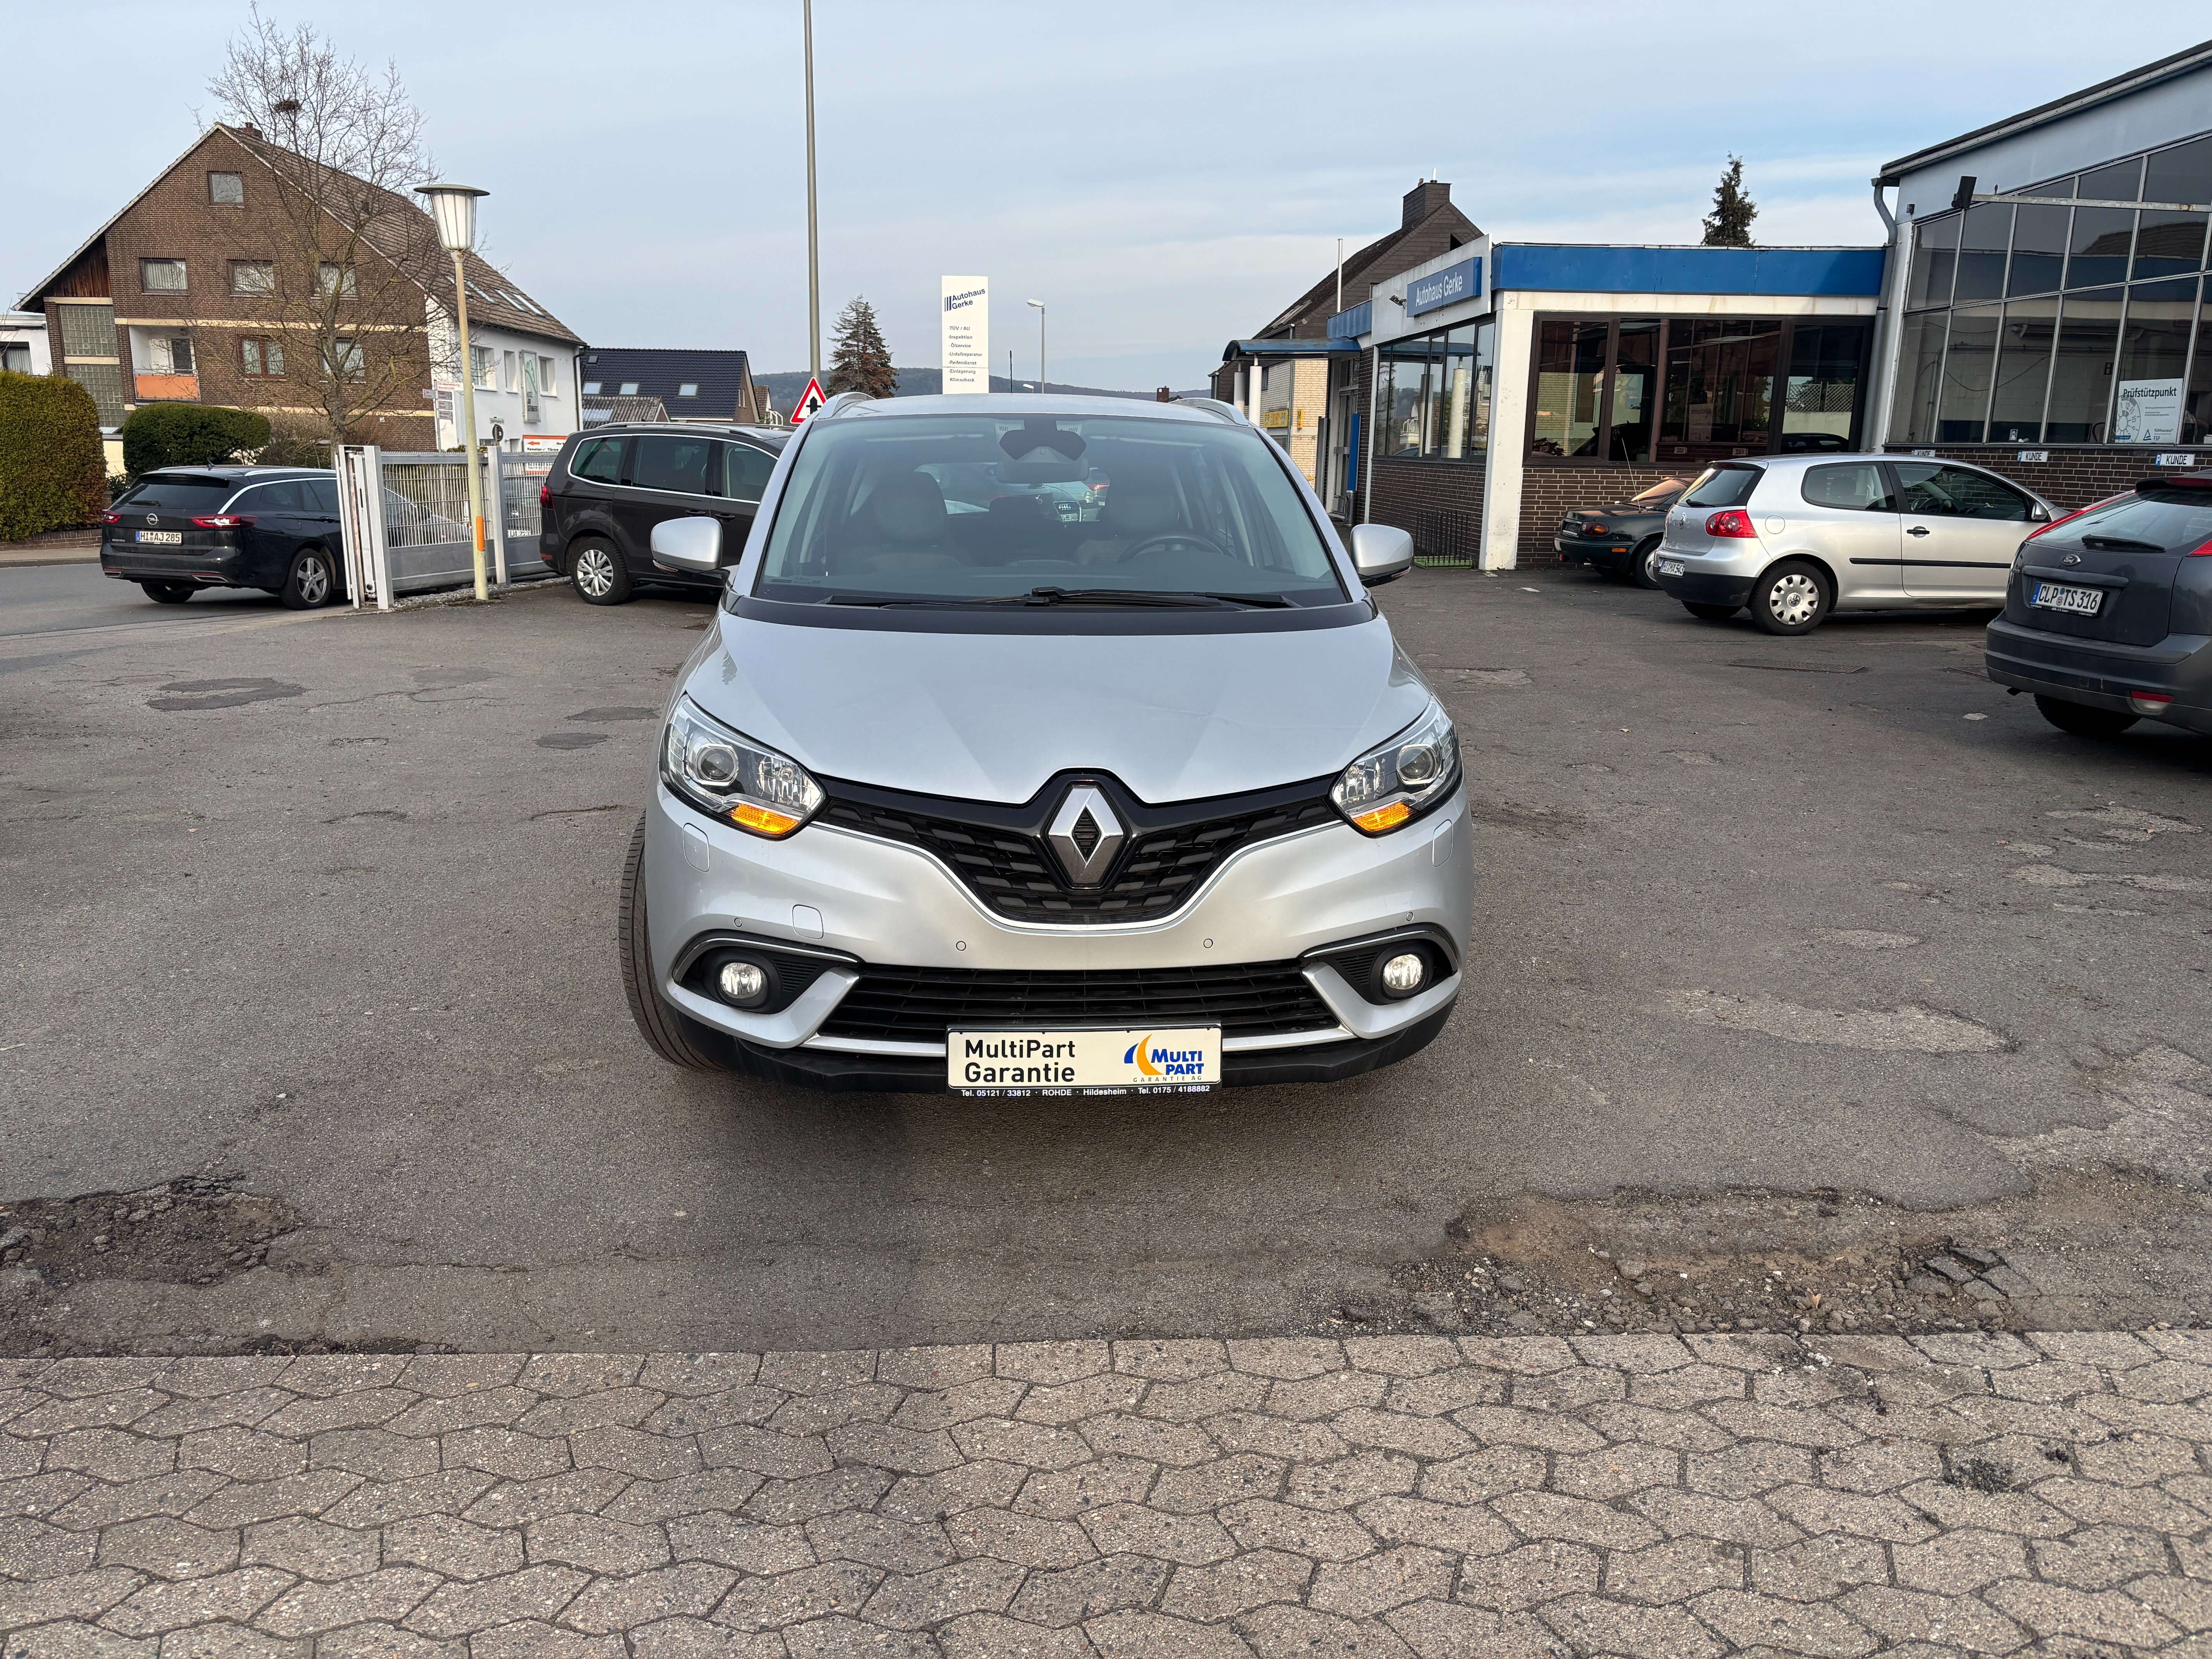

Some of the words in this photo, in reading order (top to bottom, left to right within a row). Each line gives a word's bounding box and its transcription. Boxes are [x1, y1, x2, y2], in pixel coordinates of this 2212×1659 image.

[952, 289, 986, 301] Autohaus
[1416, 283, 1442, 307] Autohaus
[1444, 272, 1463, 297] Gerke
[952, 300, 973, 309] Gerke
[2123, 386, 2177, 399] Prüfstützpunkt
[2026, 452, 2042, 460] KUNDE
[2156, 455, 2161, 465] P
[2166, 455, 2188, 465] KUNDE
[141, 532, 149, 541] HI
[154, 533, 164, 541] AJ
[166, 534, 180, 542] 285
[2039, 586, 2058, 603] CLP
[2063, 589, 2077, 606] TS
[2077, 592, 2099, 610] 316
[965, 1040, 1075, 1058] MultiPart
[1151, 1049, 1202, 1063] MULTI
[965, 1062, 1075, 1082] Garantie
[1166, 1063, 1204, 1075] PART
